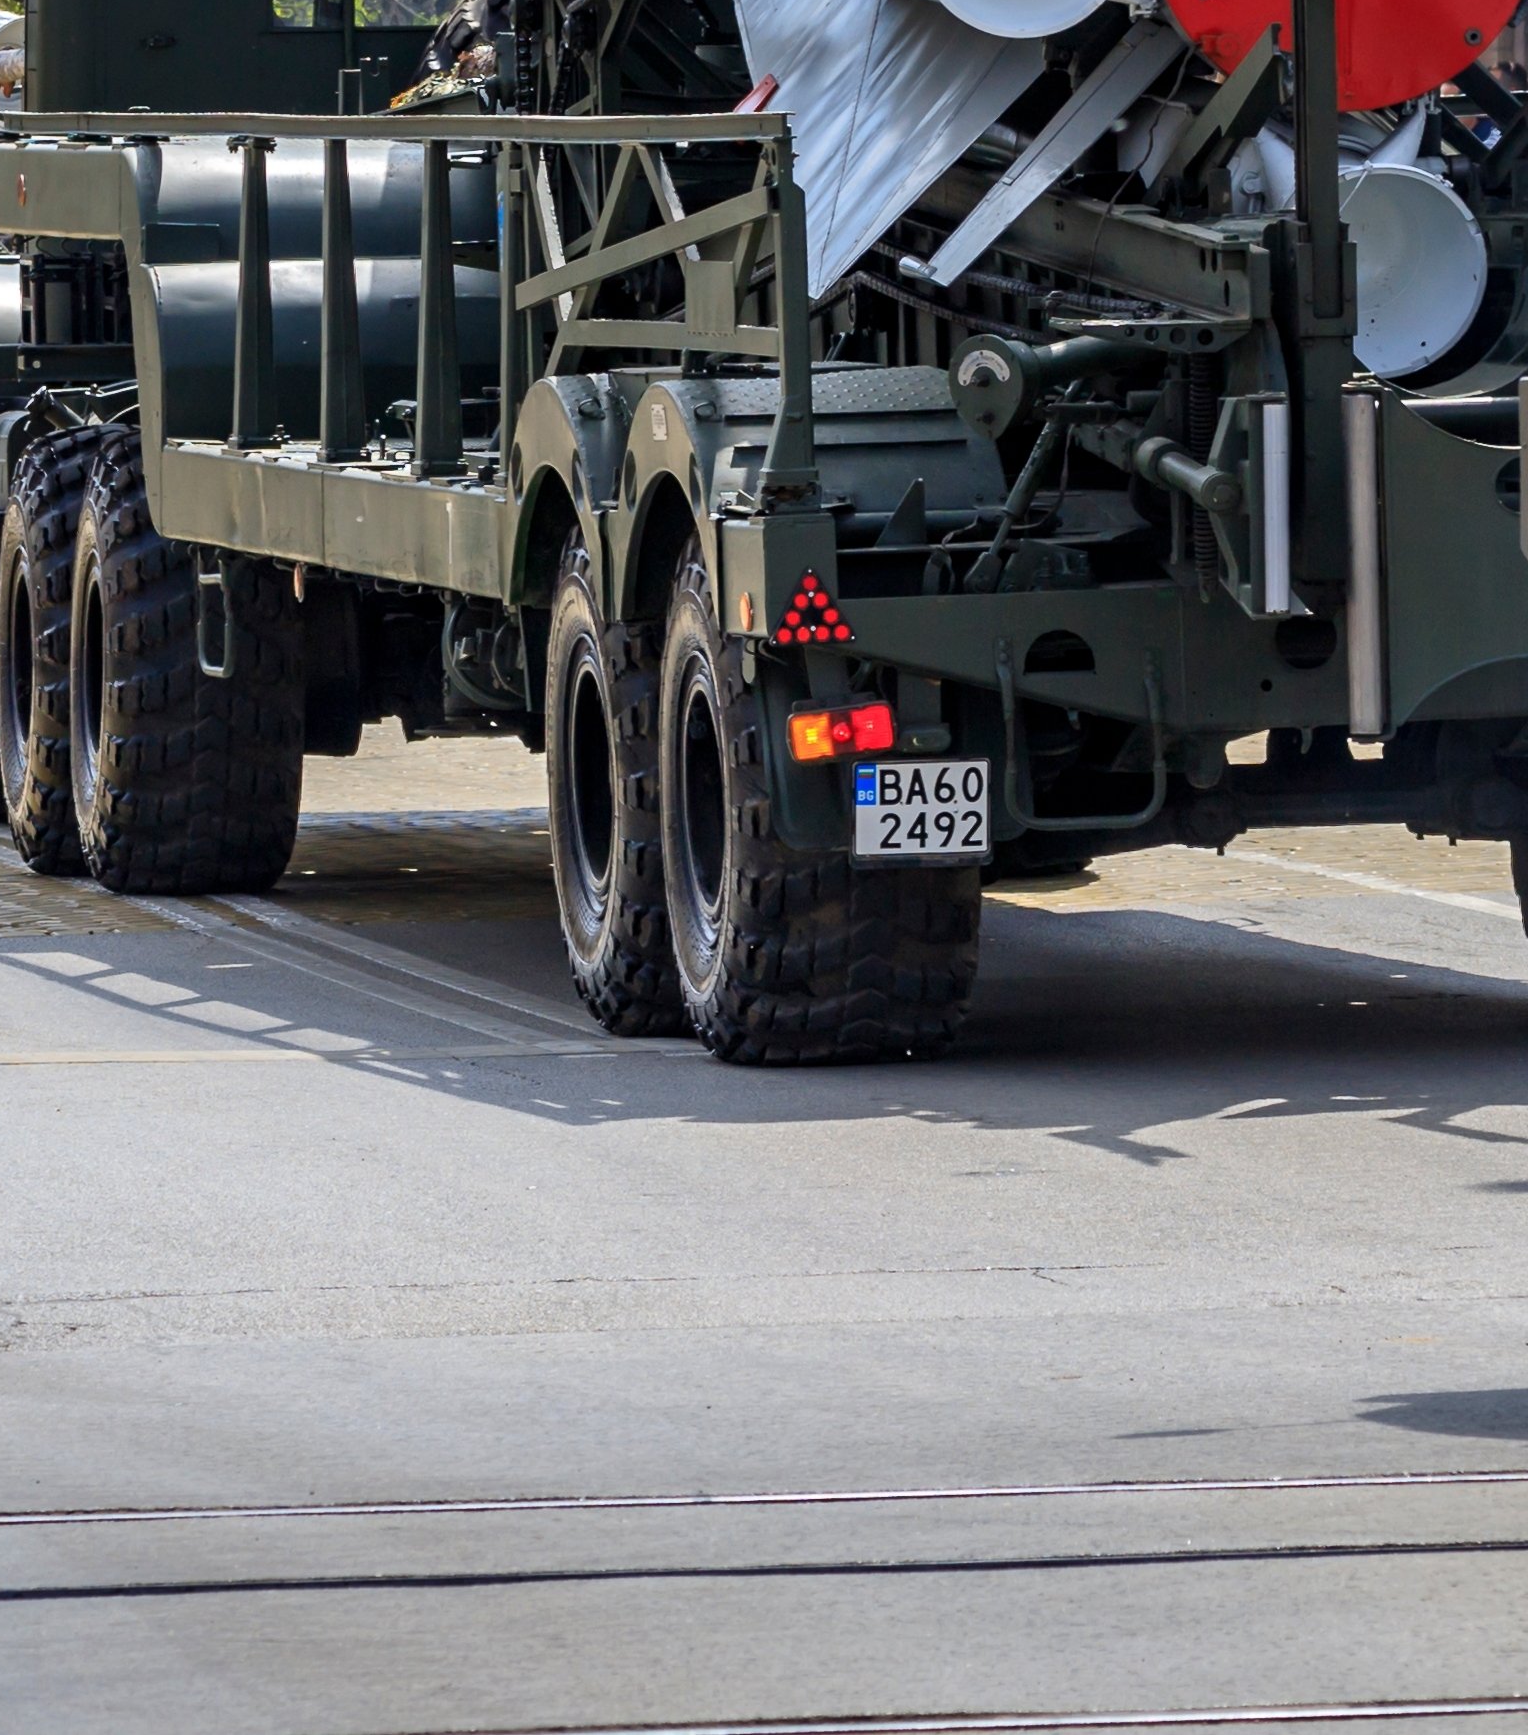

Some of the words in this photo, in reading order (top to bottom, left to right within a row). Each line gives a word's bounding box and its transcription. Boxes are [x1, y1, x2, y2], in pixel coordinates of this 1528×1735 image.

[857, 790, 875, 802] BG
[879, 766, 984, 806] BA60
[879, 810, 984, 849] 2492
